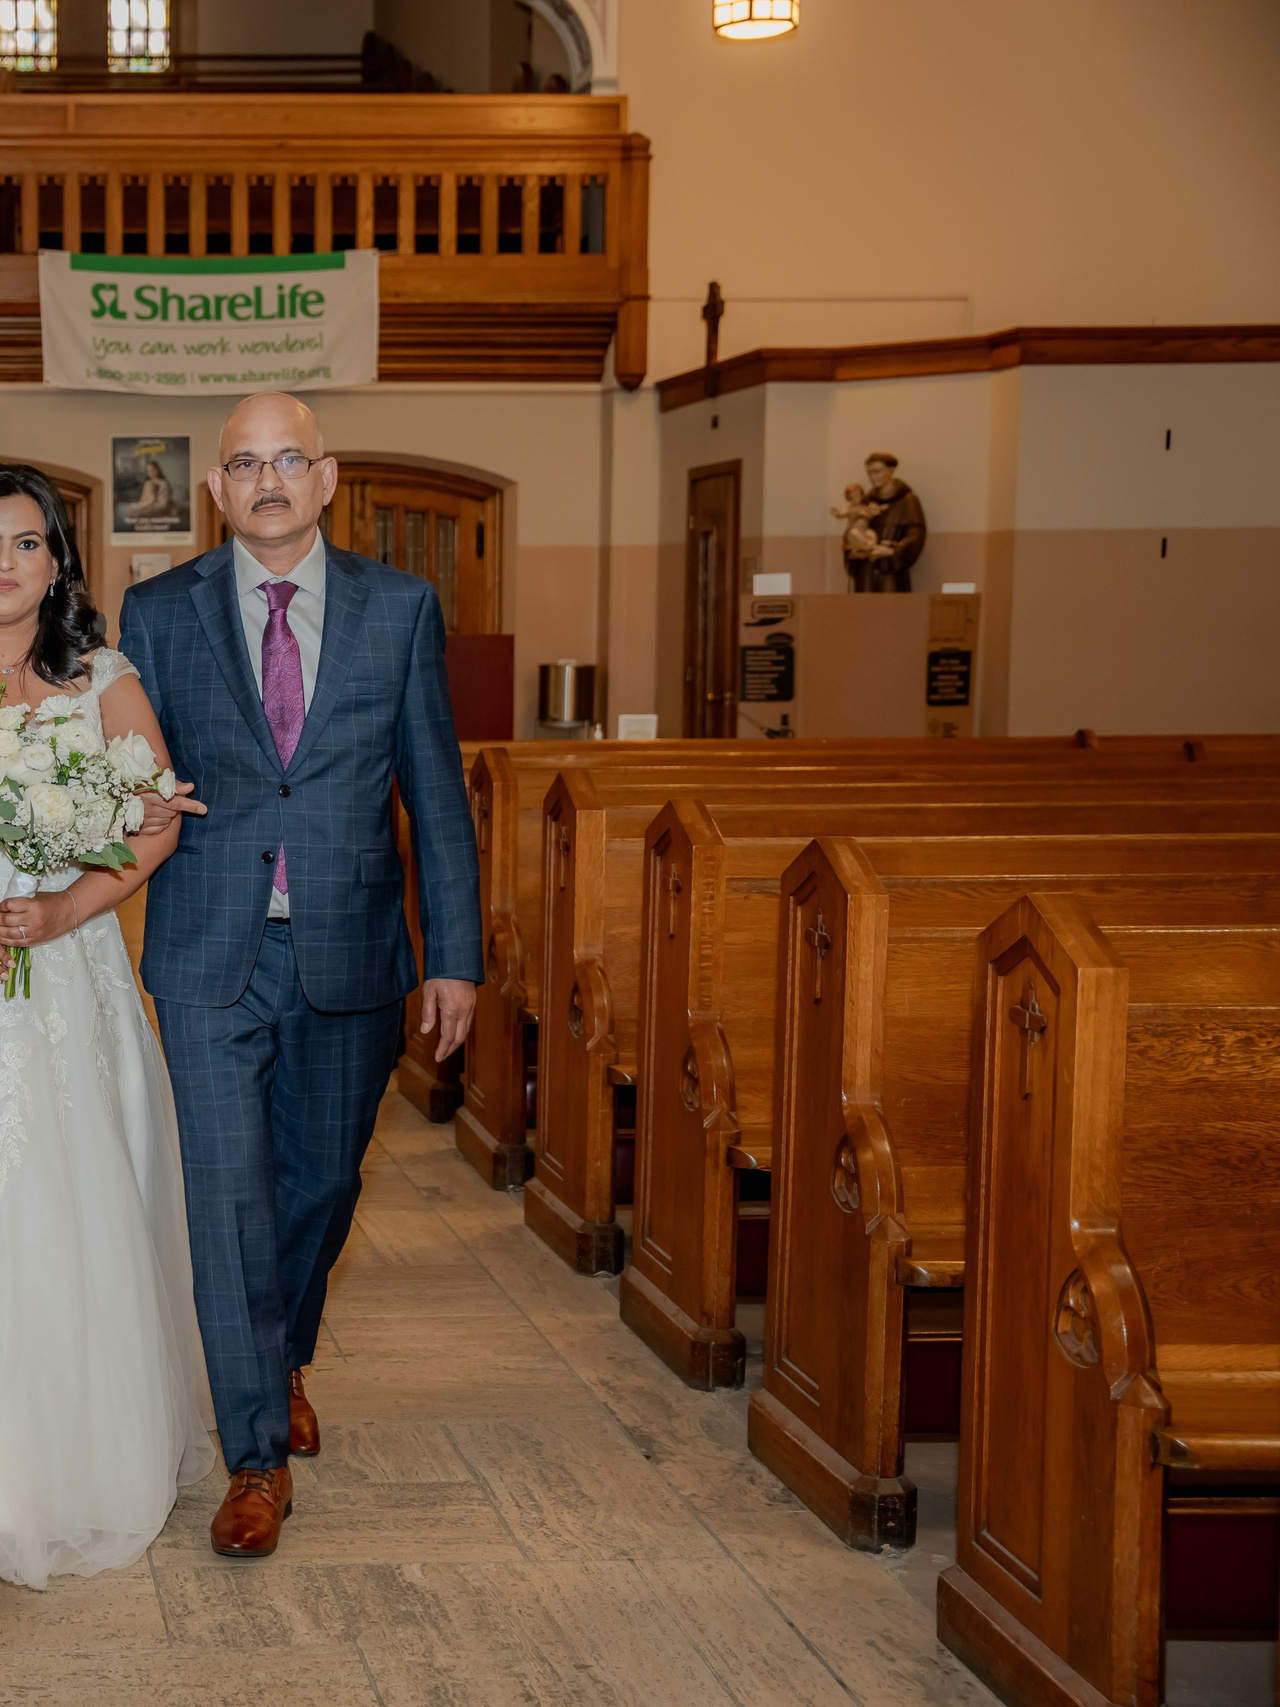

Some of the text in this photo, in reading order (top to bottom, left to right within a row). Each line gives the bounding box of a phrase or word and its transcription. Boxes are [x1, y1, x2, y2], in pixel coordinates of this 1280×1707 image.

[134, 283, 325, 322] ShareLife
[138, 340, 177, 356] can
[183, 336, 231, 357] work
[237, 332, 324, 356] wonders!
